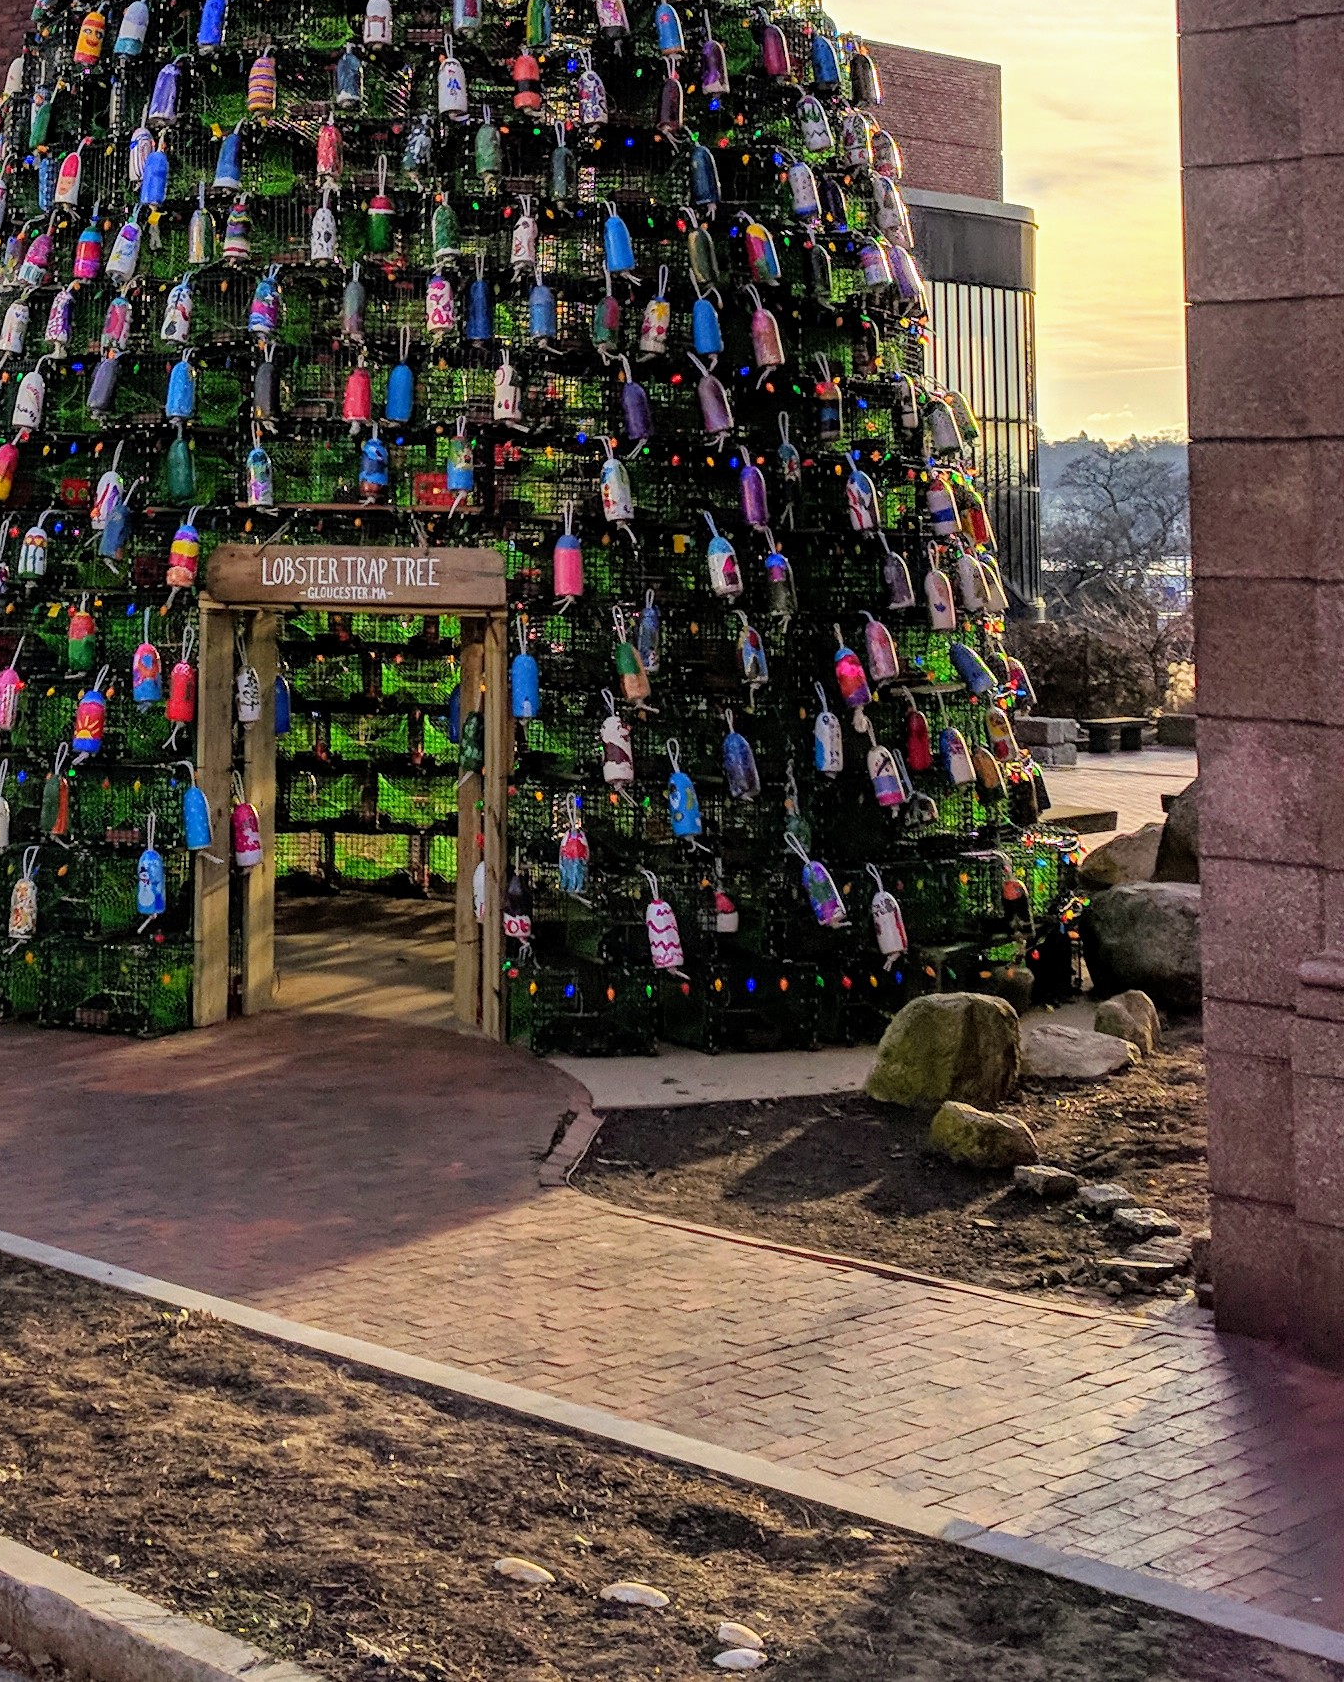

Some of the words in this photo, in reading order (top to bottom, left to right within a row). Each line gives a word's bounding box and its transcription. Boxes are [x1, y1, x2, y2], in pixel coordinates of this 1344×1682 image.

[262, 557, 339, 586] LOBSTER
[341, 556, 388, 585] TRAP
[391, 556, 440, 587] TREE
